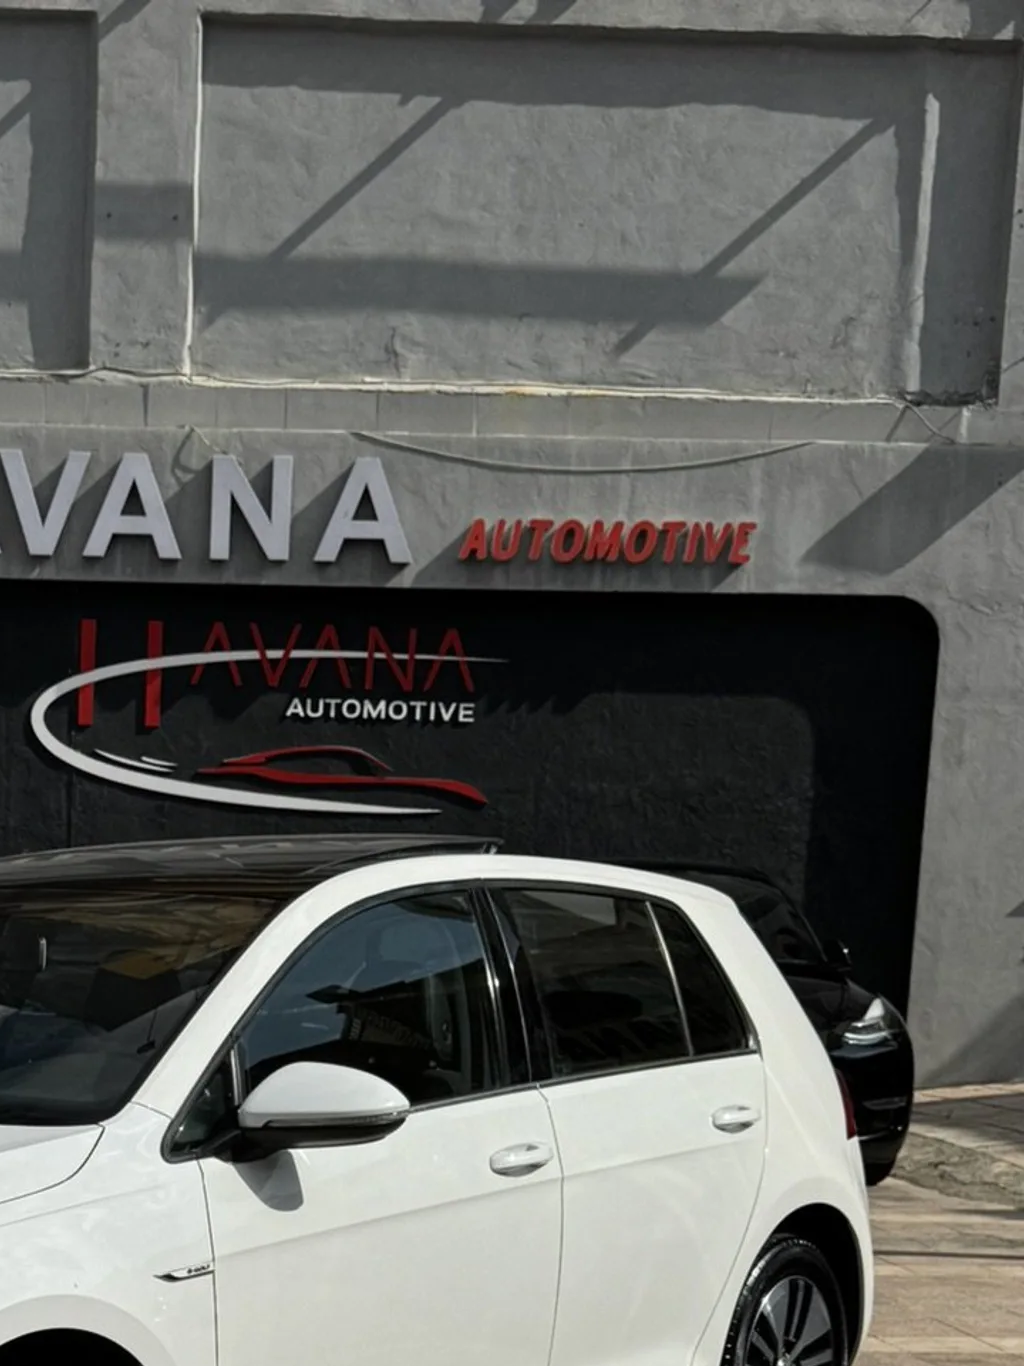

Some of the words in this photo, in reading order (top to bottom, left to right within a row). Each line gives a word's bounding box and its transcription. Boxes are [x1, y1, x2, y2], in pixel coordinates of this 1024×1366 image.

[459, 517, 757, 566] AUTOMOTIVE
[76, 618, 475, 728] HAVANA
[285, 698, 475, 723] AUTOMOTIVE
